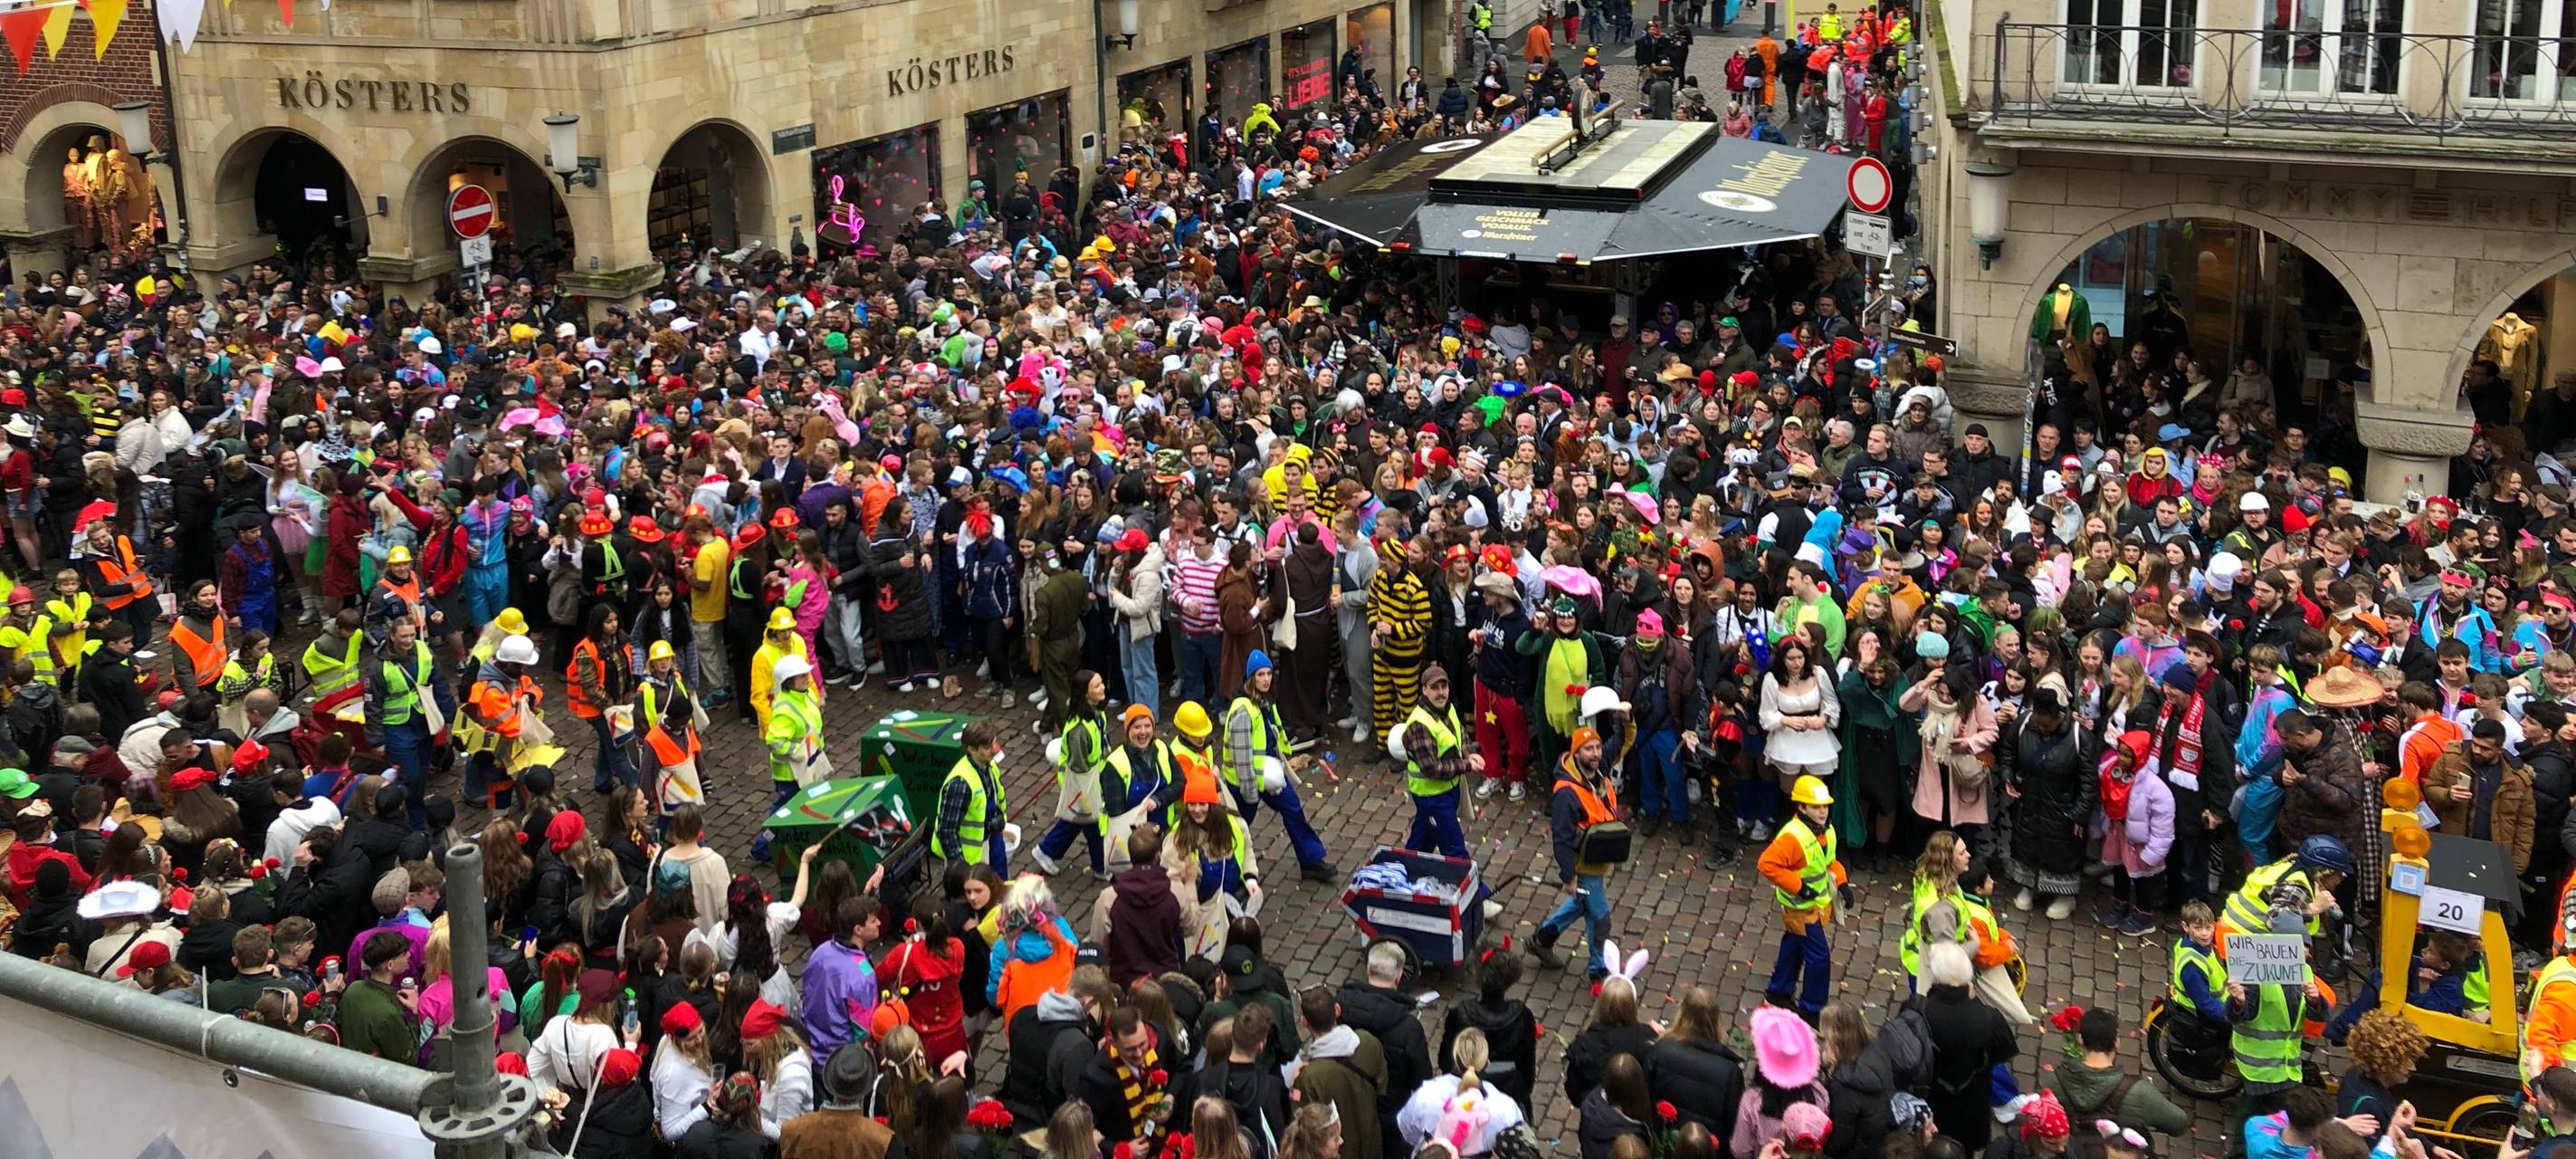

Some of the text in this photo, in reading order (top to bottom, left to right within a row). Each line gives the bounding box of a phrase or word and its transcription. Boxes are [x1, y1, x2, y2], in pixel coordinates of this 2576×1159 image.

[888, 45, 1014, 97] KÖSTERS
[277, 70, 470, 113] KÖSTERS
[1288, 72, 1331, 109] LIEBE
[2207, 180, 2391, 219] TOMMY
[1475, 216, 1550, 225] GESCHMACK
[1496, 209, 1541, 219] VOLLER
[2438, 903, 2463, 921] 20
[2228, 935, 2298, 960] WIR BAUEN
[2228, 955, 2305, 982] DIE ZUKUNFT
